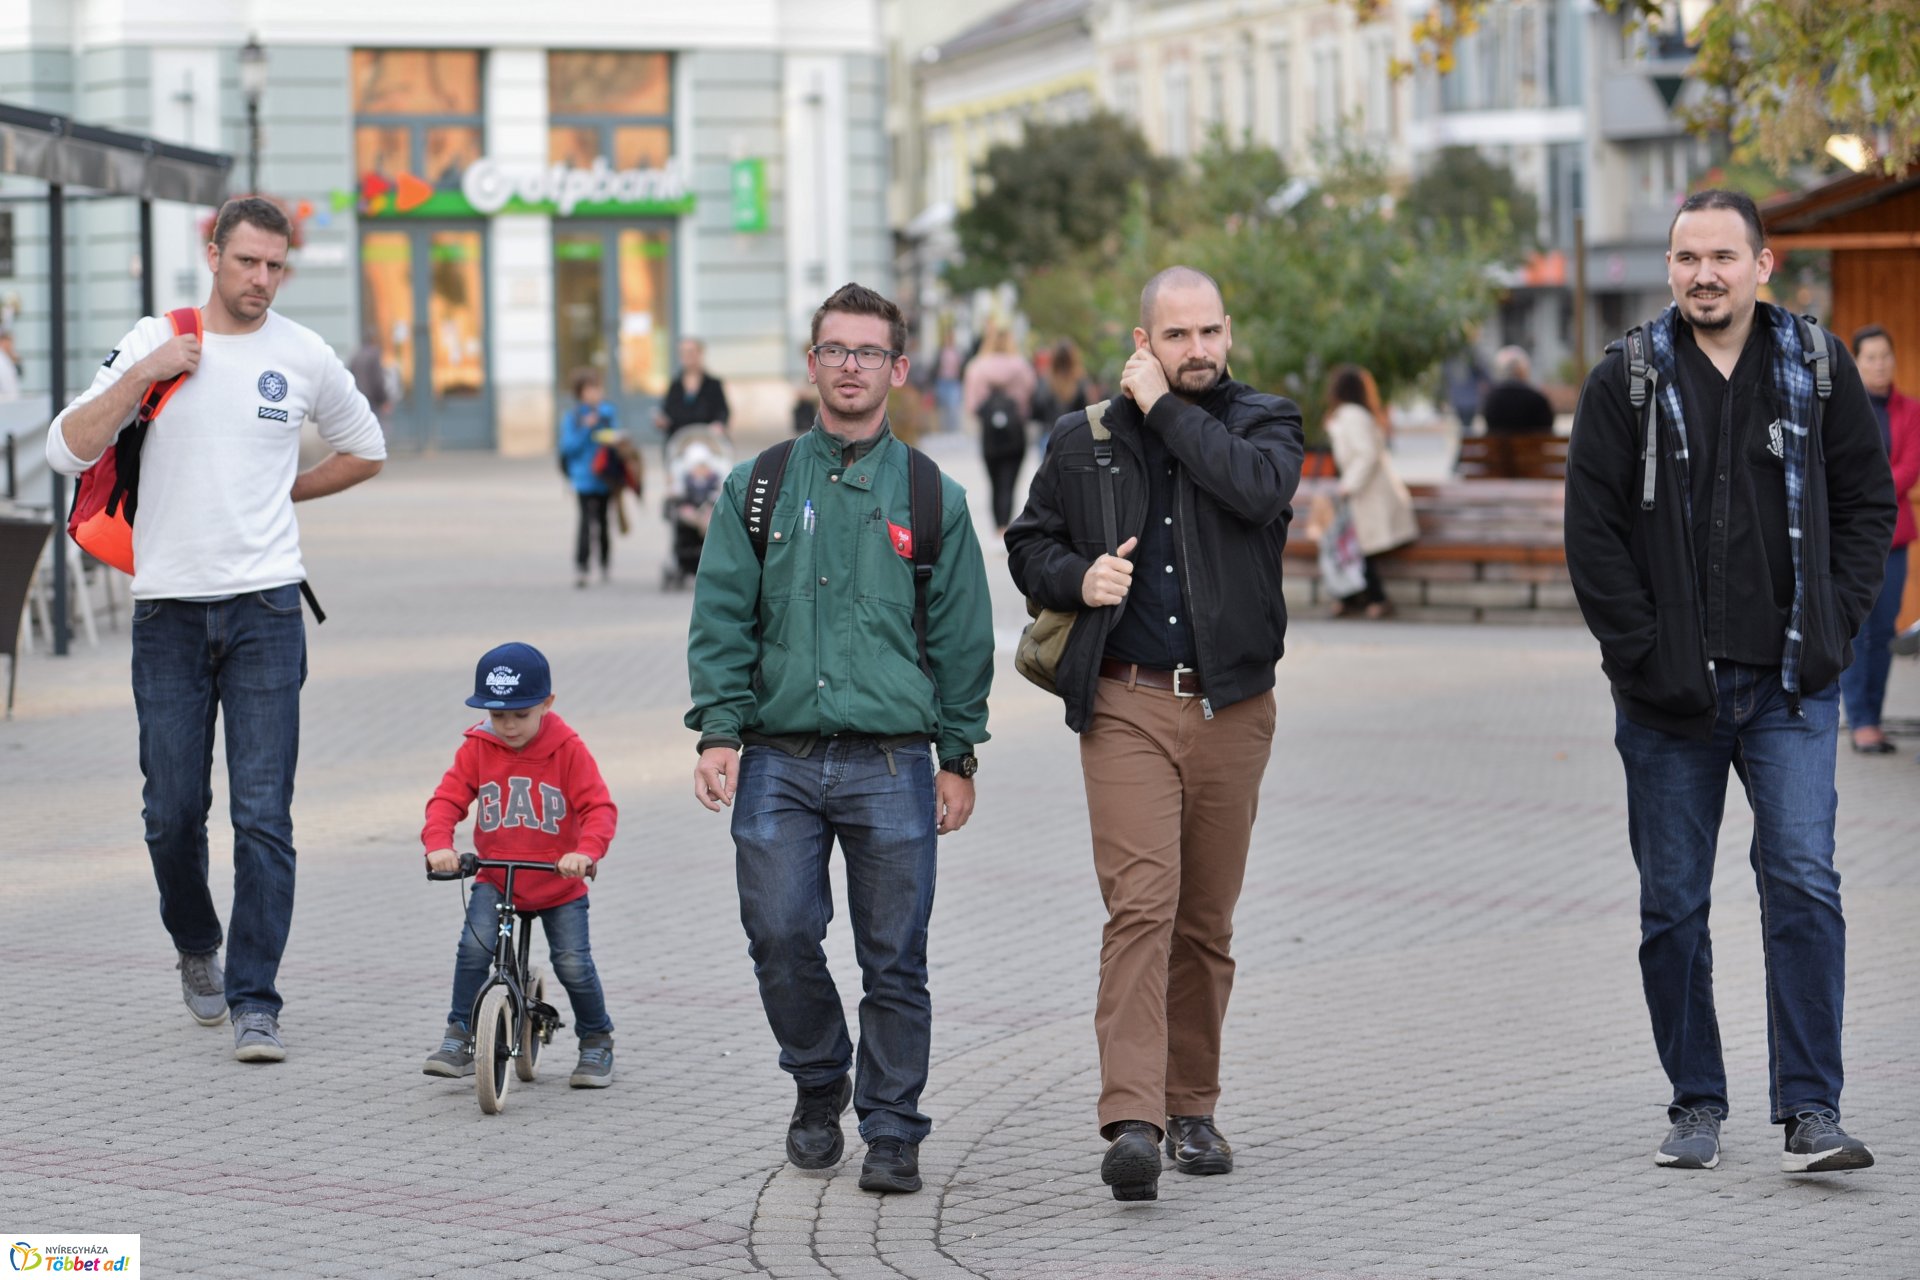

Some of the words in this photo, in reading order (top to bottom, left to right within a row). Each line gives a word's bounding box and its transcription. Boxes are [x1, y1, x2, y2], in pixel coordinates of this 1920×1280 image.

[749, 478, 769, 533] SAVAGE
[485, 671, 521, 686] Original
[493, 665, 513, 674] CUSTOM
[478, 776, 567, 835] GAP
